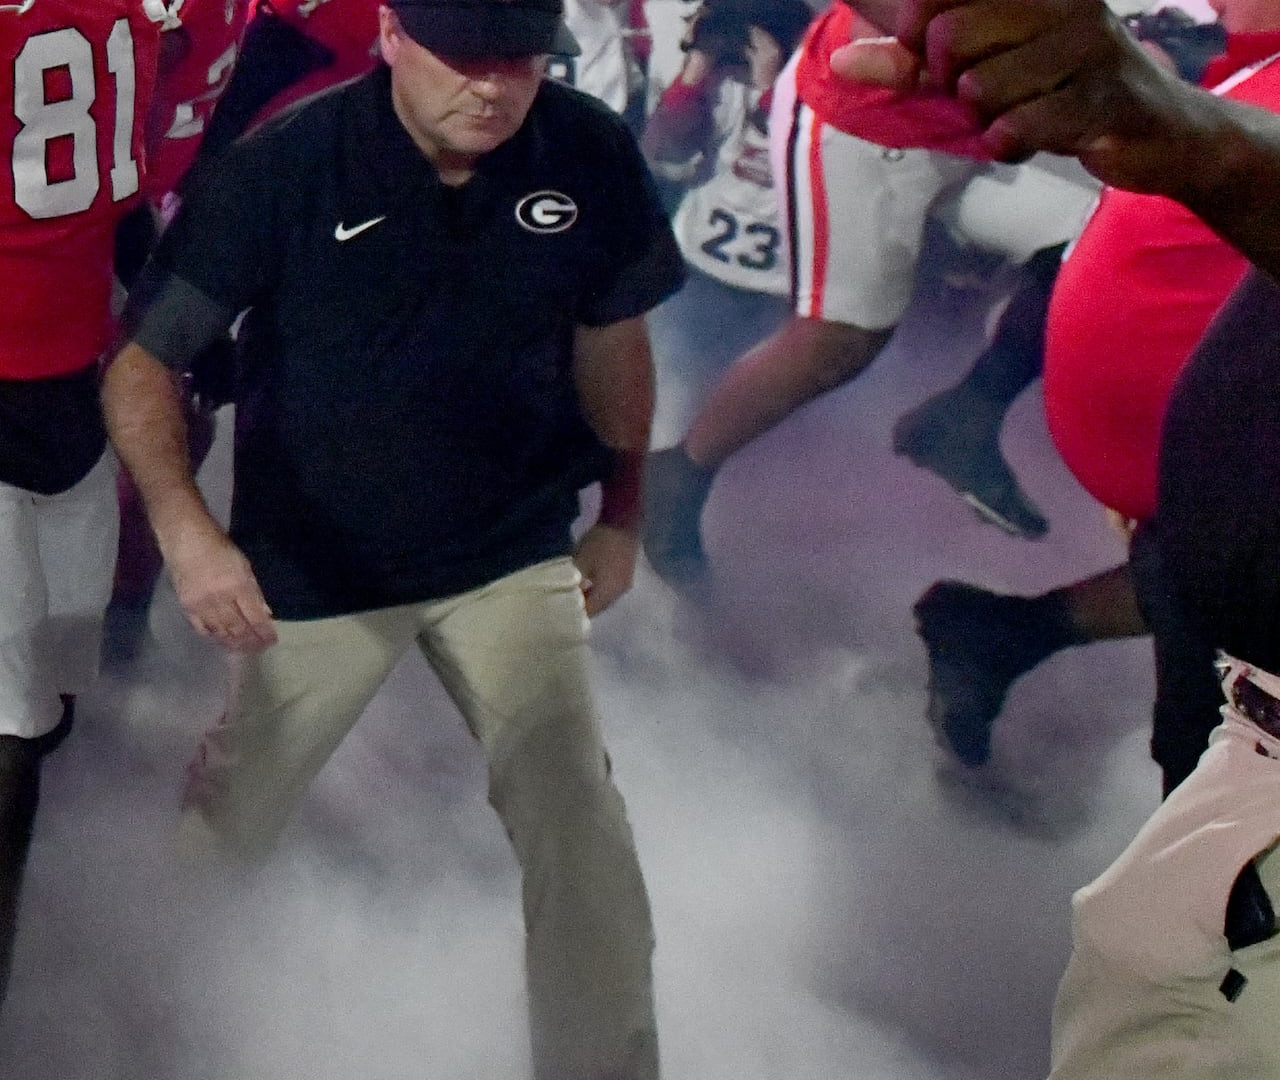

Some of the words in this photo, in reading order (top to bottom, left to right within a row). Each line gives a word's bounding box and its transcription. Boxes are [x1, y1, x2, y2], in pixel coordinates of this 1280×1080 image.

[12, 17, 139, 220] 81
[531, 198, 578, 225] G
[701, 207, 781, 270] 23
